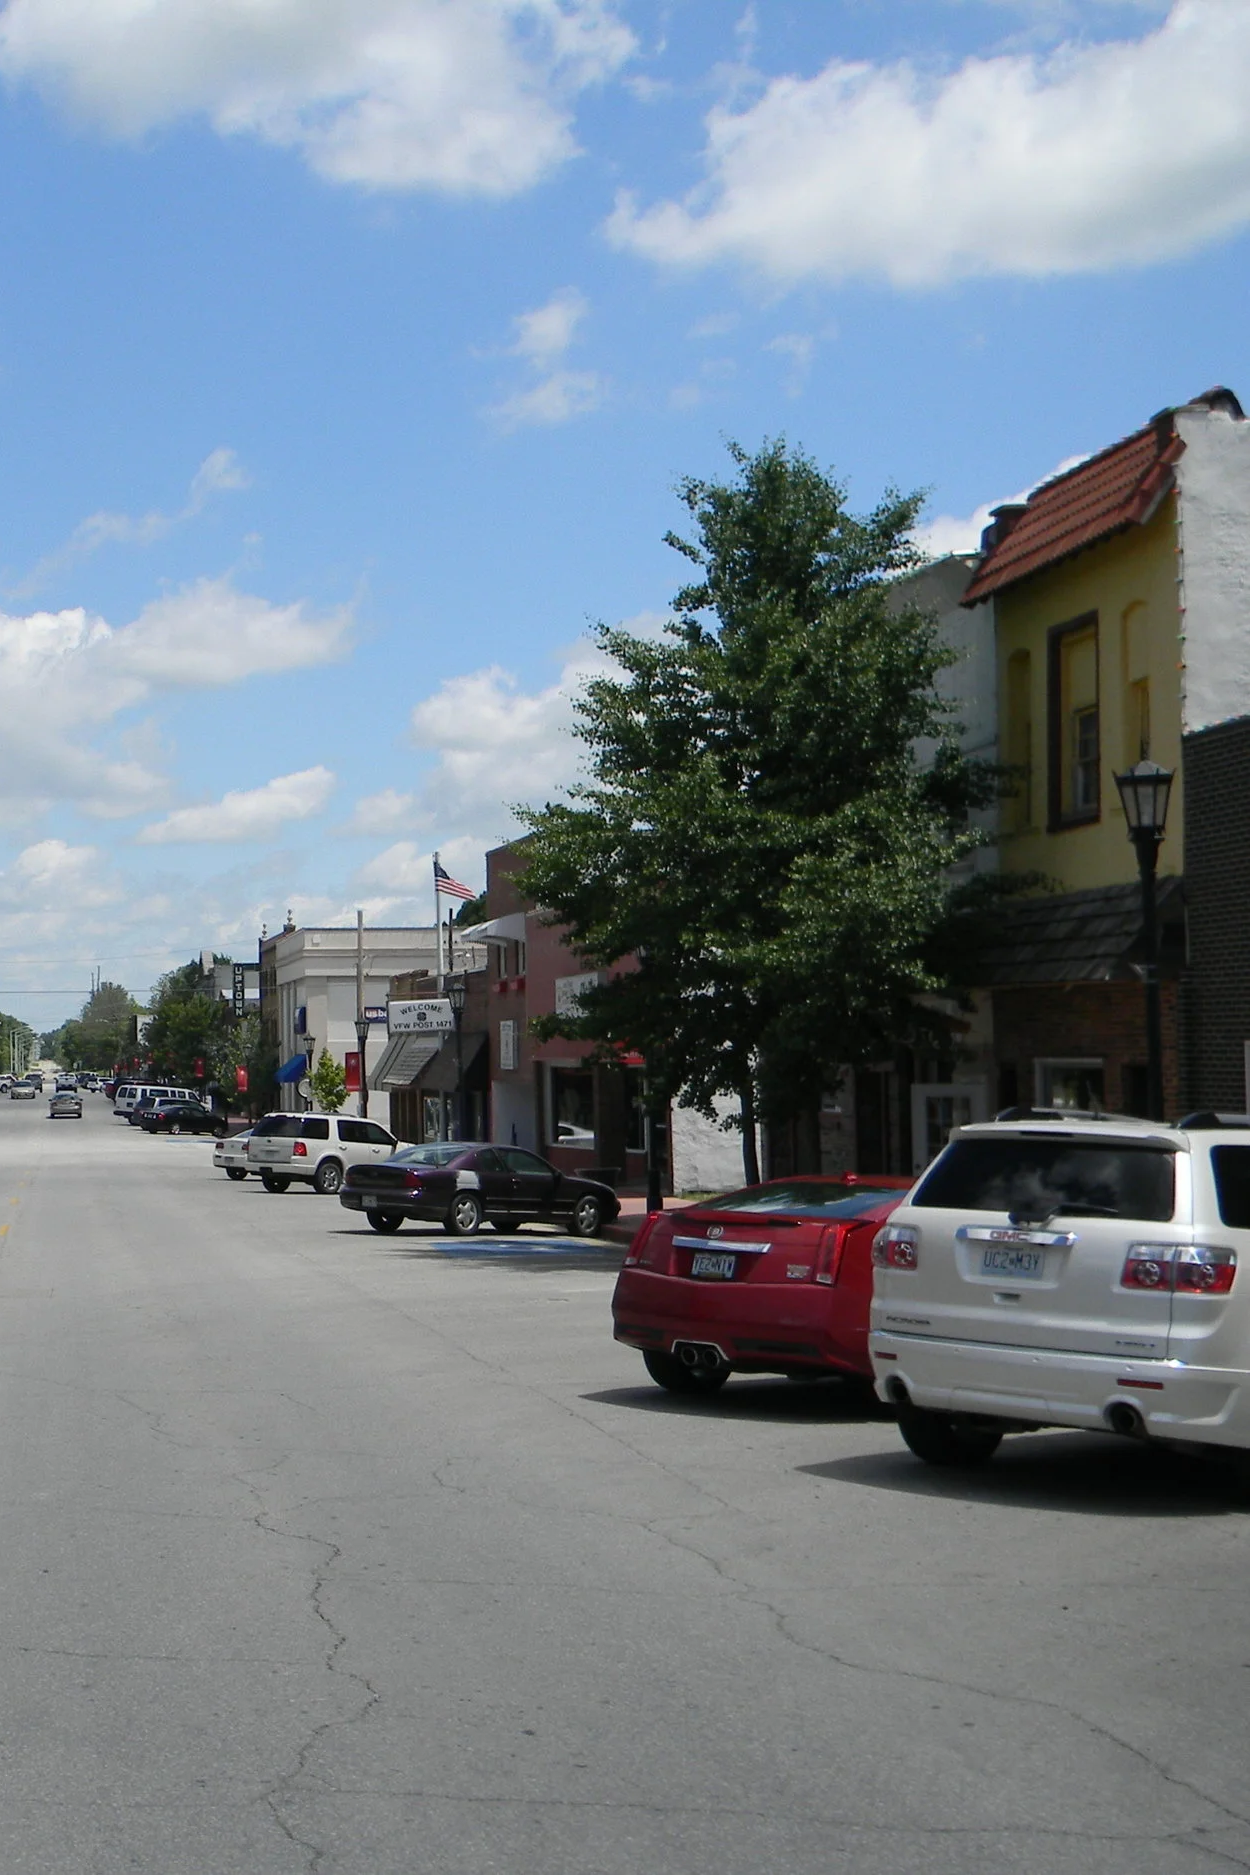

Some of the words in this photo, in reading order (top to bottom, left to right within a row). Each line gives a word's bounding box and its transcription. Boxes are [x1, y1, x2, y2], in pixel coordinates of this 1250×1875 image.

[234, 966, 243, 1016] UPTOWN
[400, 1003, 444, 1015] WELCOME
[413, 1021, 433, 1029] POST
[436, 1020, 452, 1028] 1471
[990, 1230, 1029, 1241] GMC
